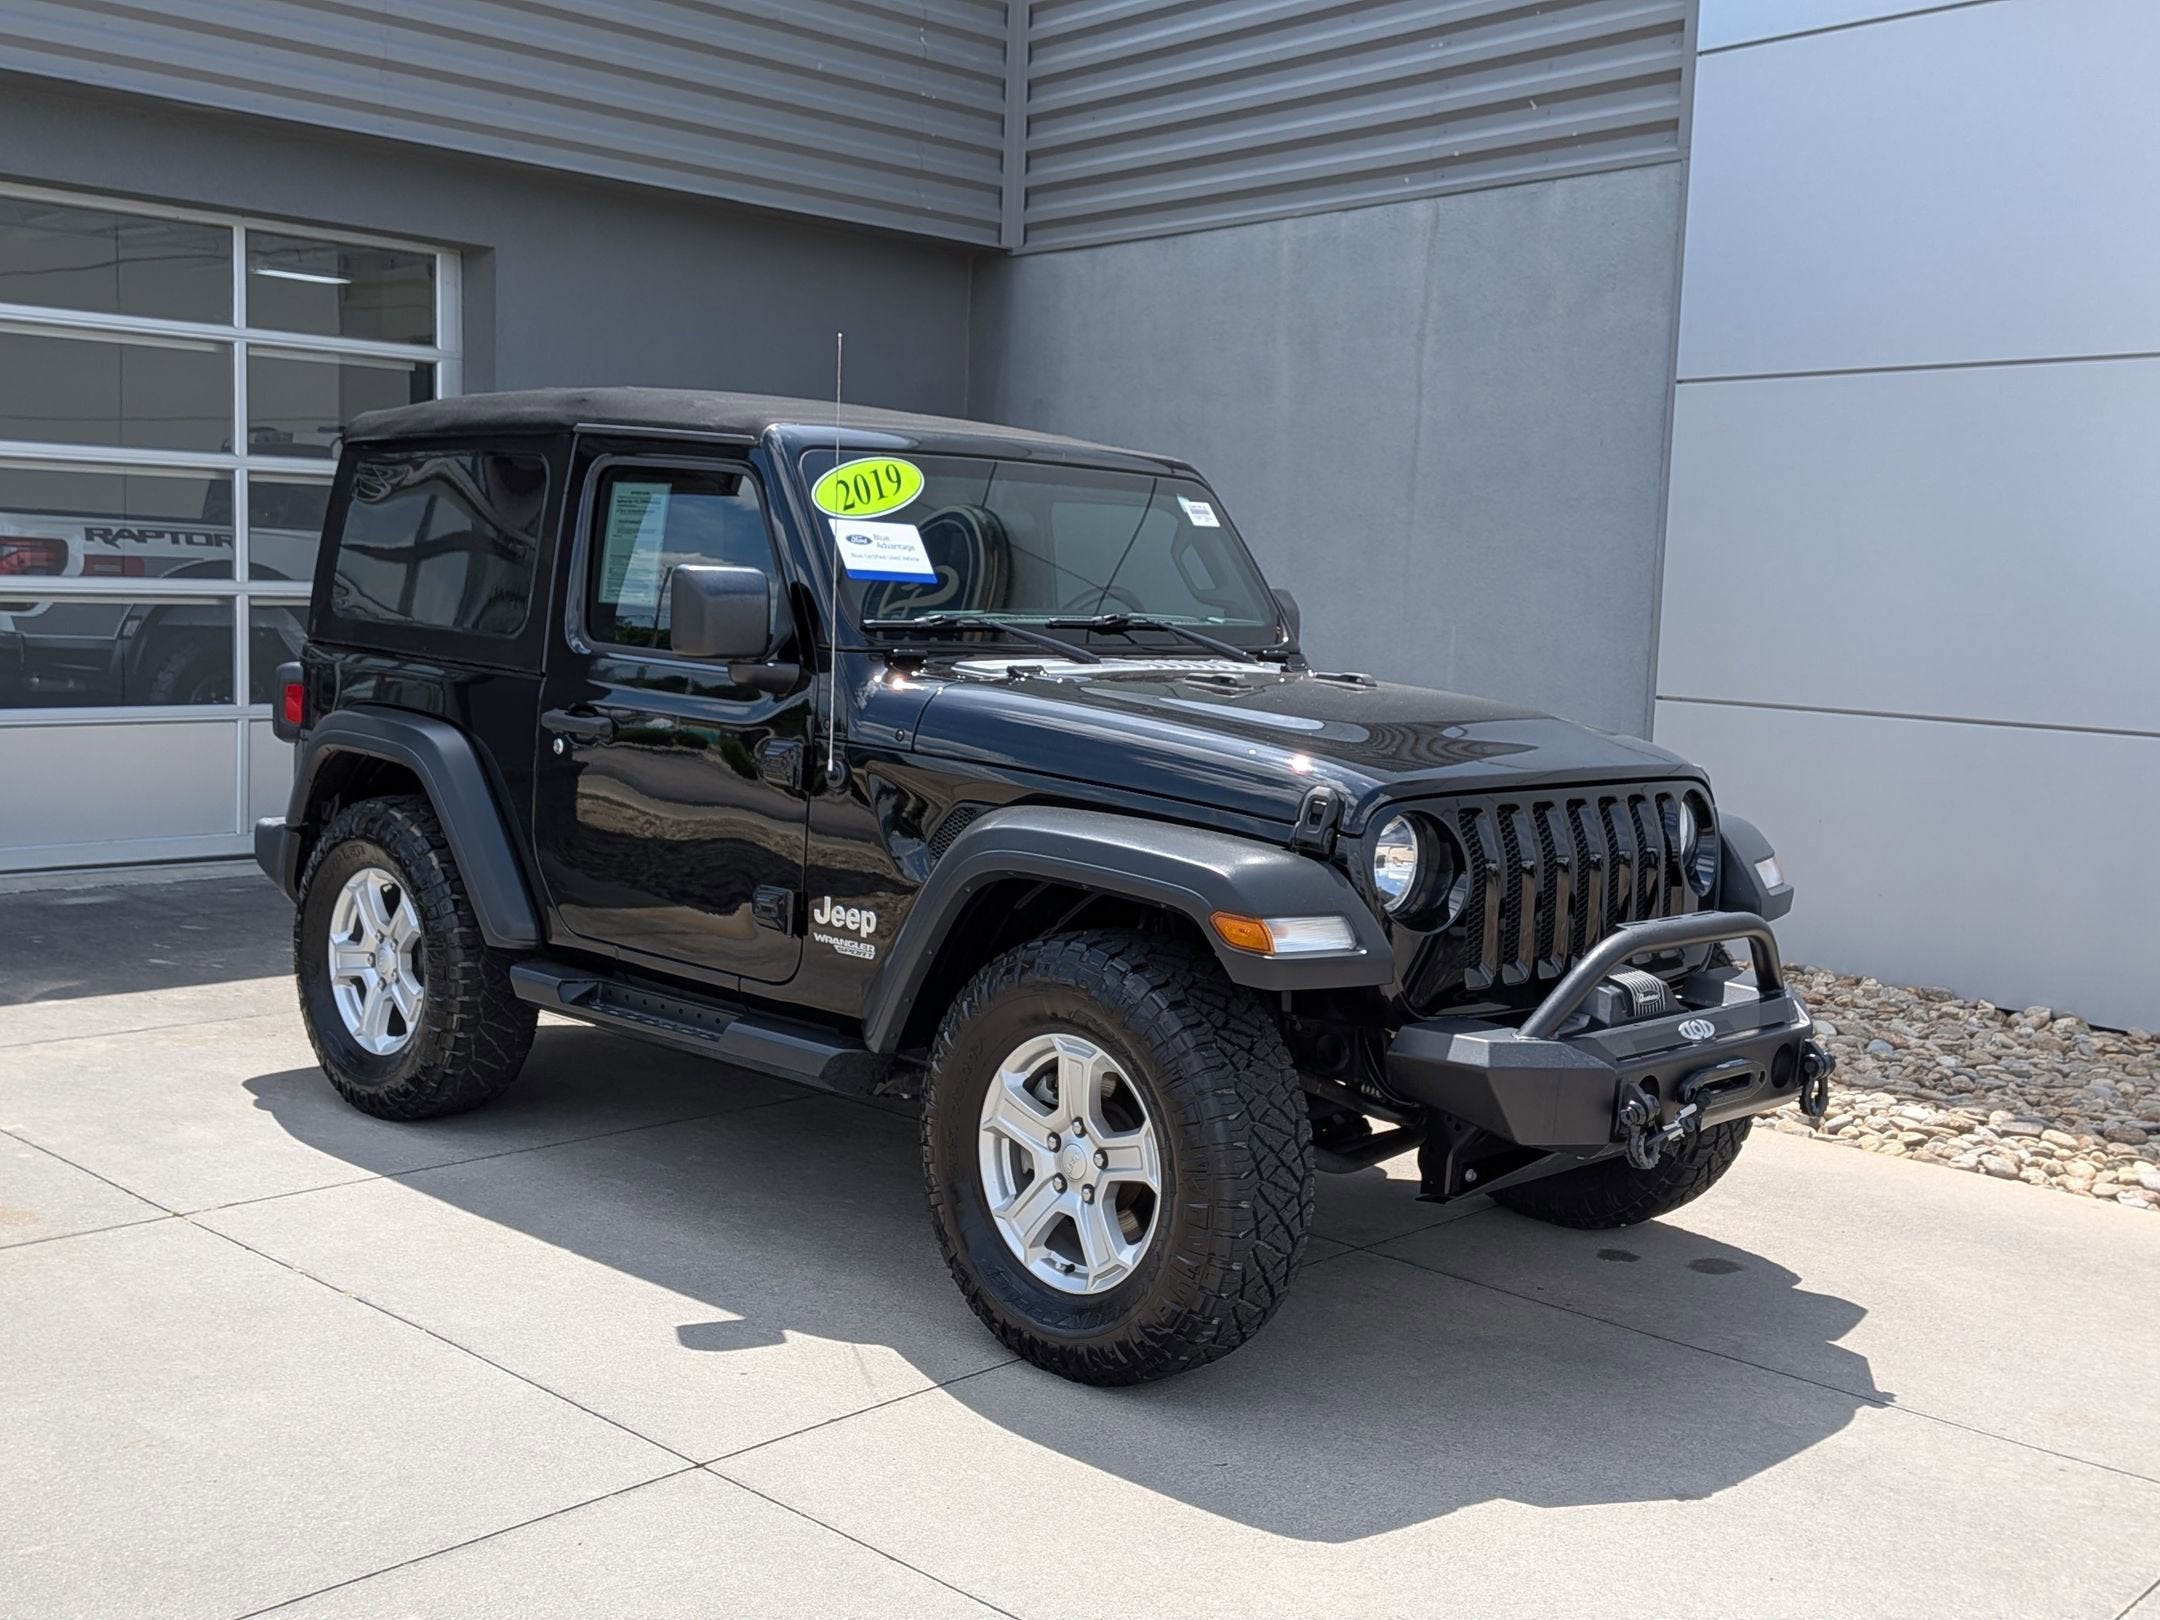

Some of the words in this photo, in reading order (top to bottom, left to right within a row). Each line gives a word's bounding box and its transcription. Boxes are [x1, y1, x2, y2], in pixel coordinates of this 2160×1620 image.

[836, 464, 902, 511] 2019
[84, 527, 233, 549] RAPTOR
[813, 896, 877, 938] Jeep
[813, 932, 875, 953] WRANGLER
